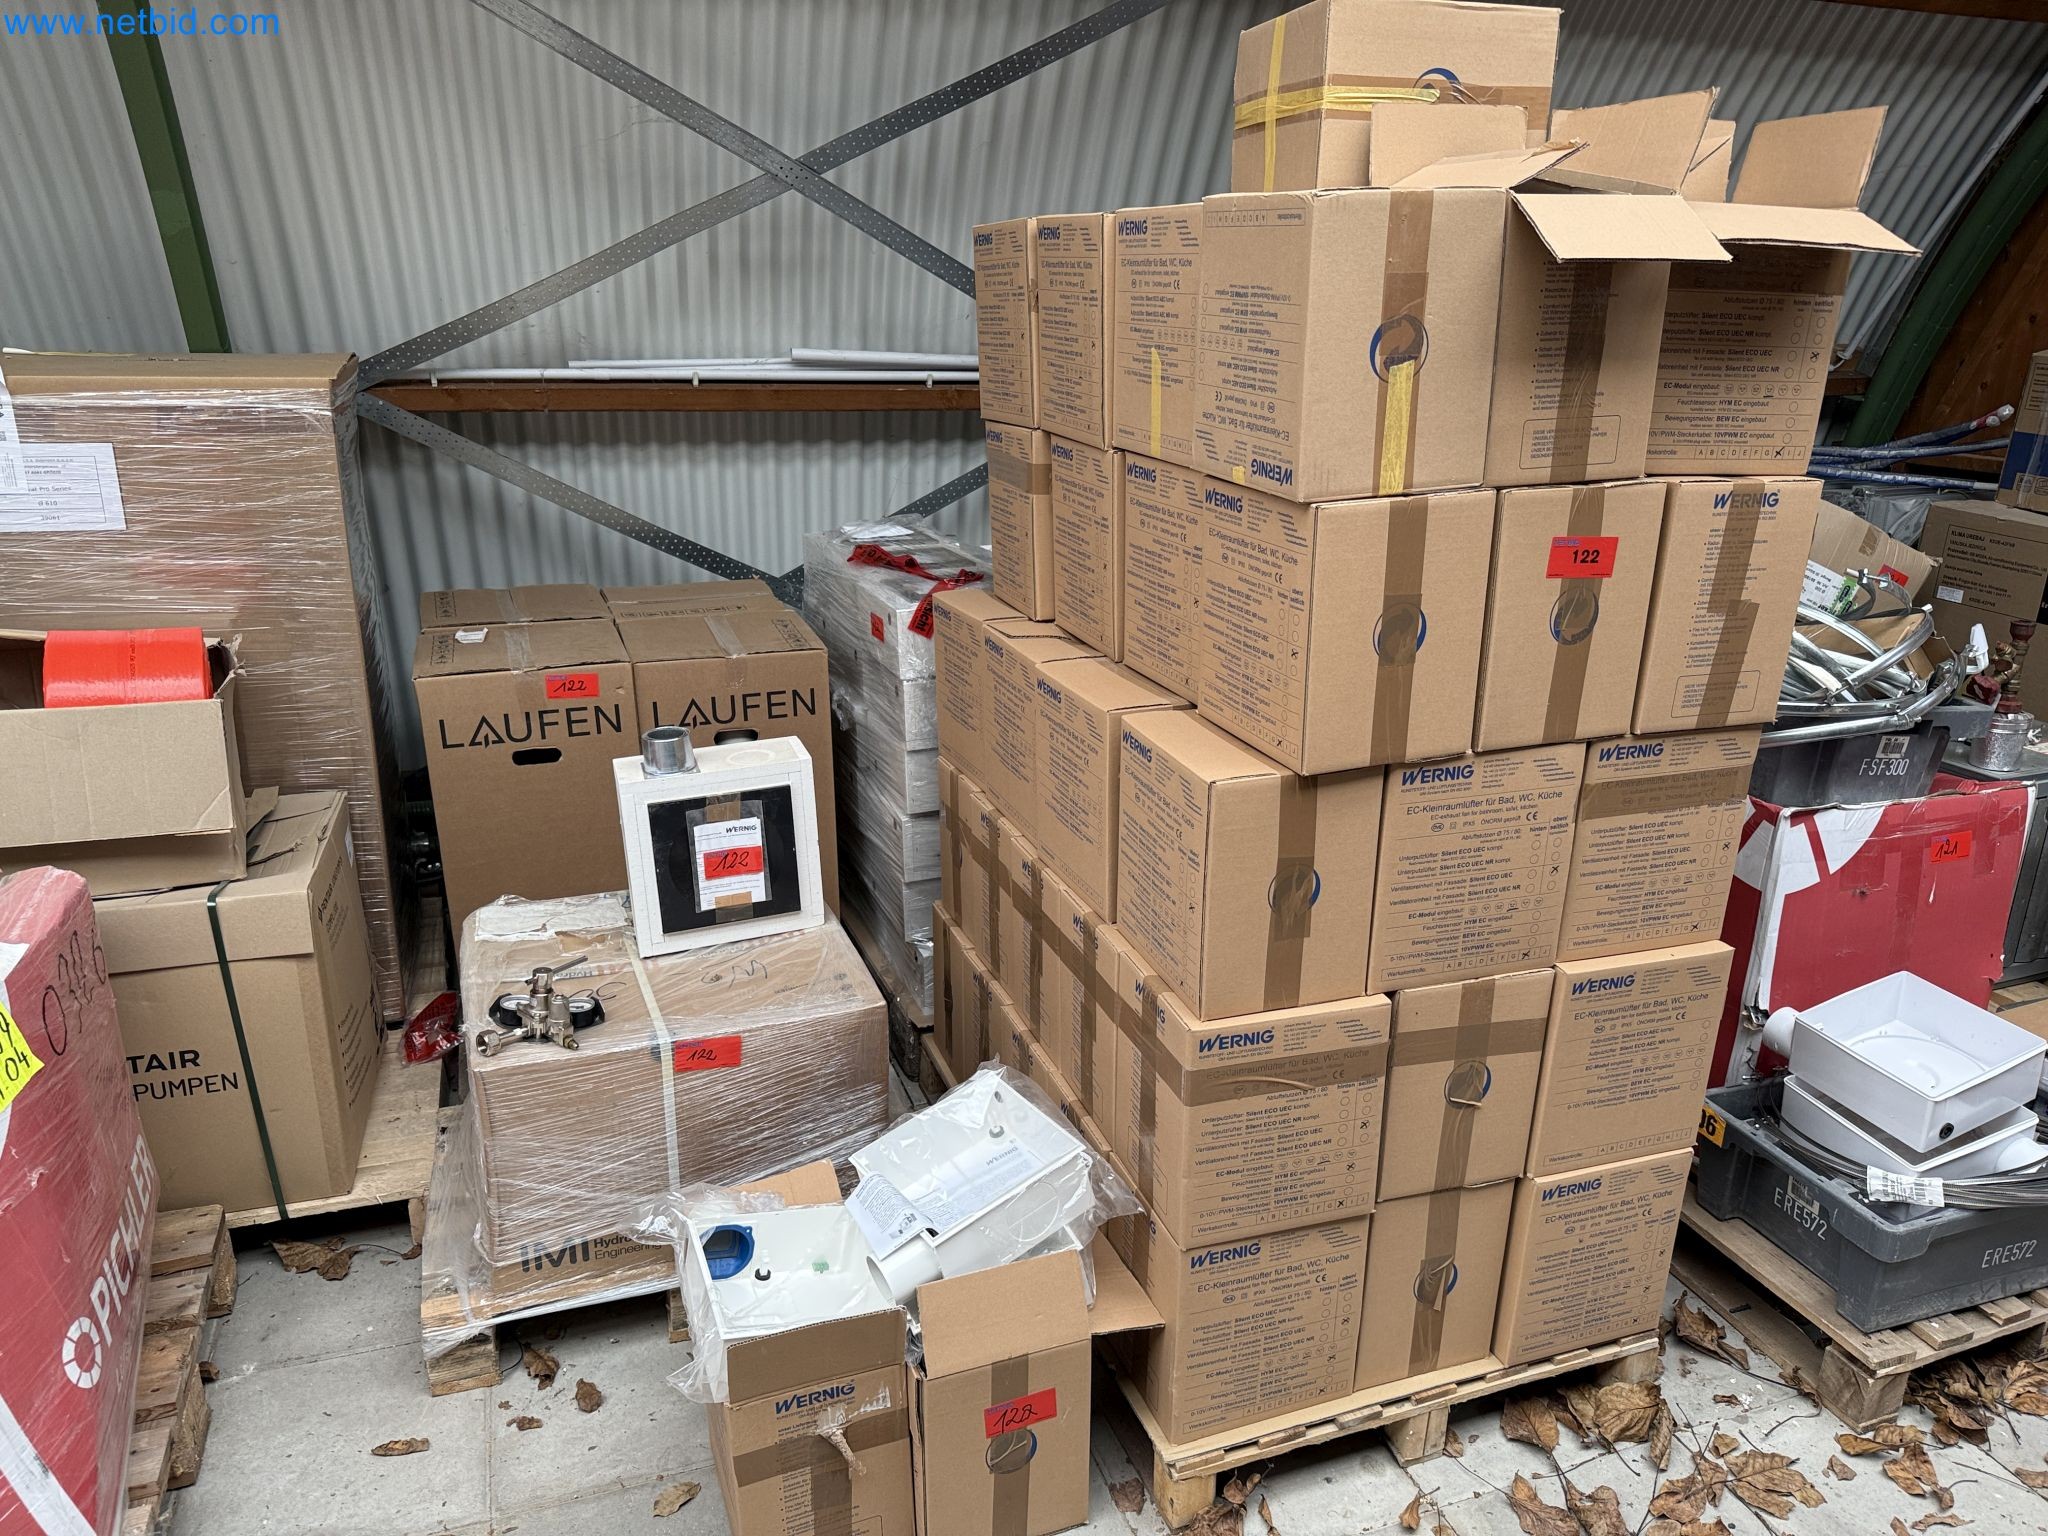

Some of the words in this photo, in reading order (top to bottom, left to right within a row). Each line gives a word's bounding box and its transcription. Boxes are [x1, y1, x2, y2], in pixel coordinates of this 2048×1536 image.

[1038, 225, 1061, 241] WERNIG
[1118, 218, 1148, 236] WERNIG
[974, 232, 993, 247] WERNIG
[986, 429, 1003, 443] WERNIG
[1052, 442, 1073, 461] WERNIG
[1127, 461, 1156, 483] WERNIG
[1251, 458, 1293, 486] WERNIG
[1205, 488, 1243, 513] WERNIG
[1713, 491, 1779, 509] WERNIG
[1572, 549, 1600, 564] 122
[934, 602, 951, 622] WERNIG
[984, 635, 1004, 659] WERNIG
[553, 680, 587, 693] 122
[1036, 678, 1062, 704] WERNIG
[652, 688, 816, 729] LAUFEN
[438, 703, 622, 749] LAUFEN
[1122, 729, 1152, 763] WERNIG
[1599, 742, 1664, 762] WERNIG
[1401, 765, 1474, 786] WERNIG
[1858, 758, 1910, 776] FSF300
[1407, 798, 1484, 815] EC-Kleinraumlüfter
[1485, 797, 1495, 806] für
[1538, 790, 1563, 800] Küche
[725, 824, 757, 834] WERNIG
[712, 851, 749, 871] 122
[1457, 861, 1470, 869] ECO
[1487, 873, 1500, 881] ECO
[1572, 974, 1635, 995] WERNIG
[1199, 1029, 1275, 1053] WERNIG
[686, 1048, 718, 1062] 122
[132, 1072, 239, 1102] PUMPEN
[1264, 1107, 1278, 1115] ECO
[1542, 1178, 1602, 1201] WERNIG
[1774, 1186, 1828, 1241] ERE572
[90, 1134, 154, 1349] PICHLER
[1190, 1242, 1261, 1269] WERNIG
[1325, 1253, 1350, 1266] Küche
[1982, 1240, 2038, 1270] ERE572
[775, 1382, 856, 1414] WERNIG
